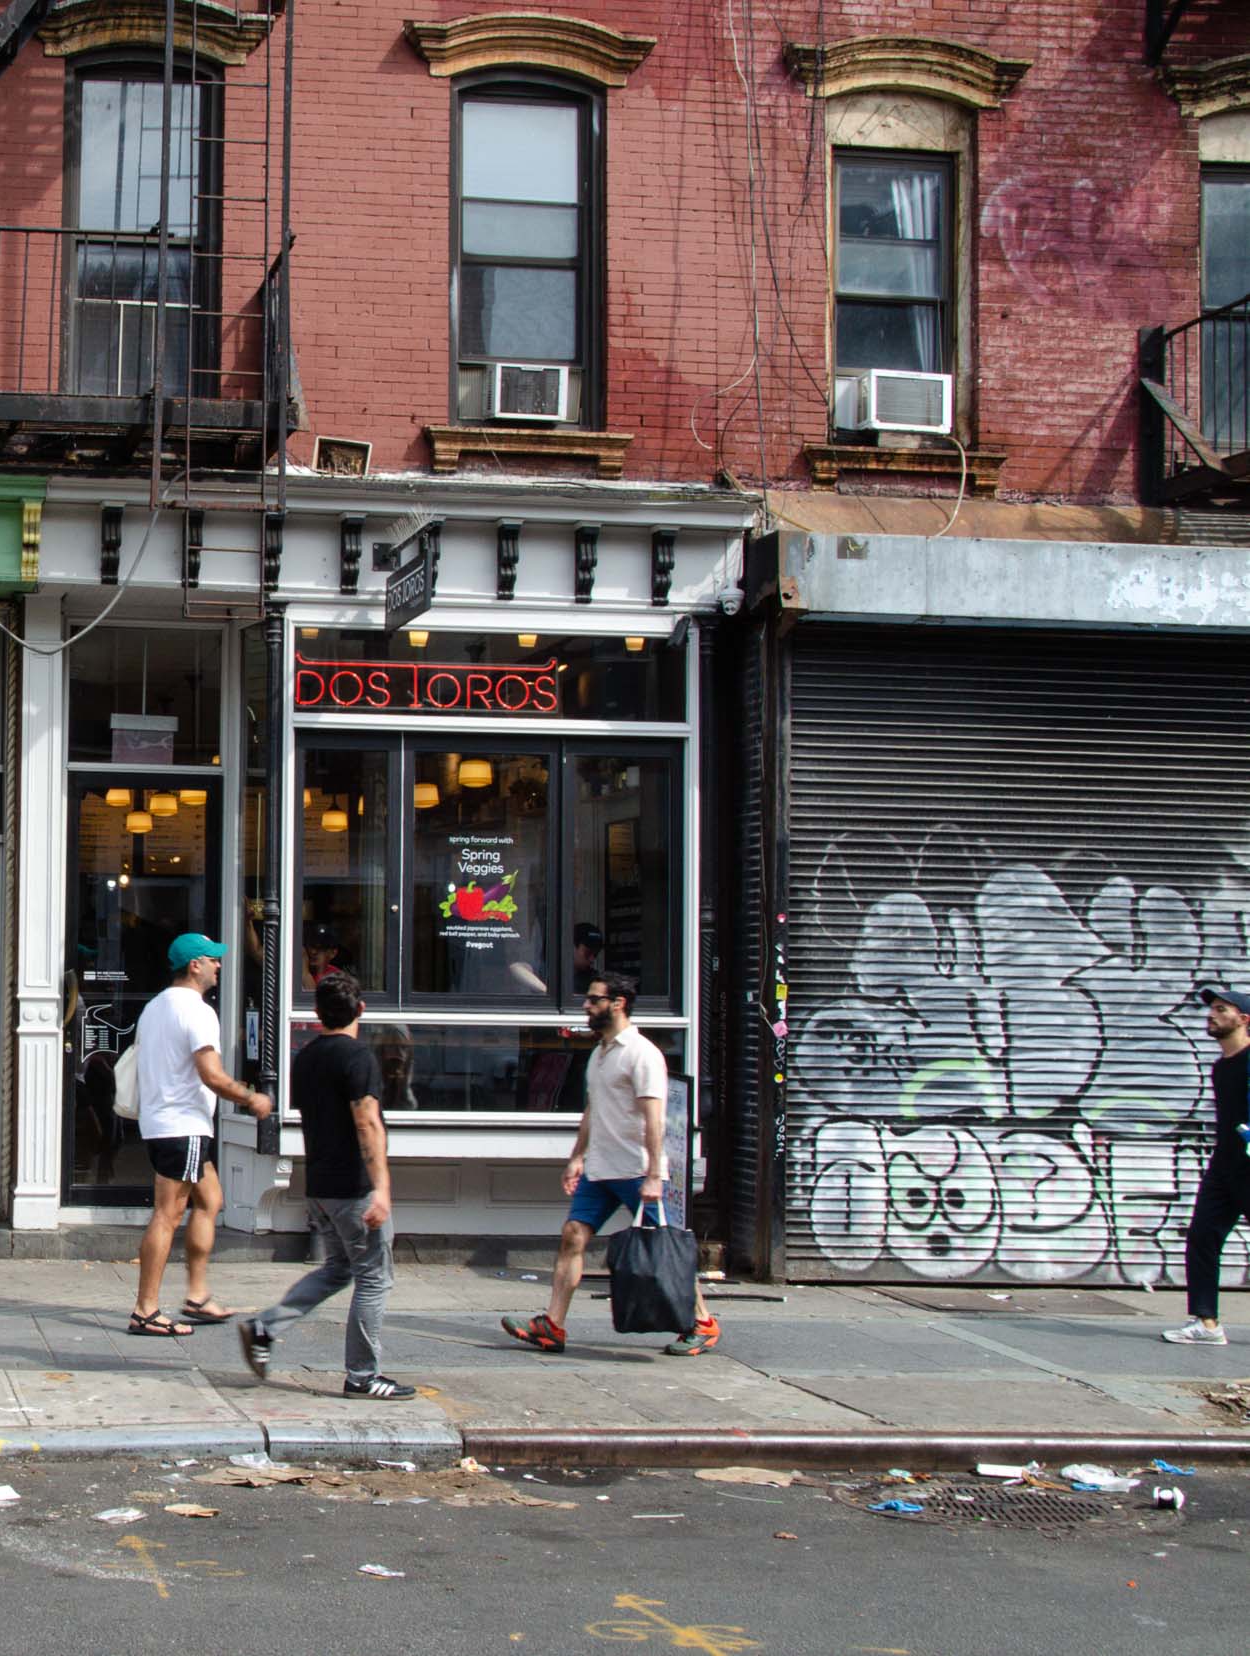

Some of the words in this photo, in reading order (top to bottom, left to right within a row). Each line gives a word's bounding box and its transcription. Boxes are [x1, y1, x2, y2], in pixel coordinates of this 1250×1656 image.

[387, 586, 402, 613] DOS
[402, 570, 425, 603] TOROS
[295, 669, 391, 708] DOS
[408, 664, 558, 711] TOROS
[449, 836, 470, 844] spring
[471, 836, 498, 844] forward
[461, 848, 501, 863] Spring
[457, 862, 504, 876] Veggies
[249, 1017, 256, 1046] A
